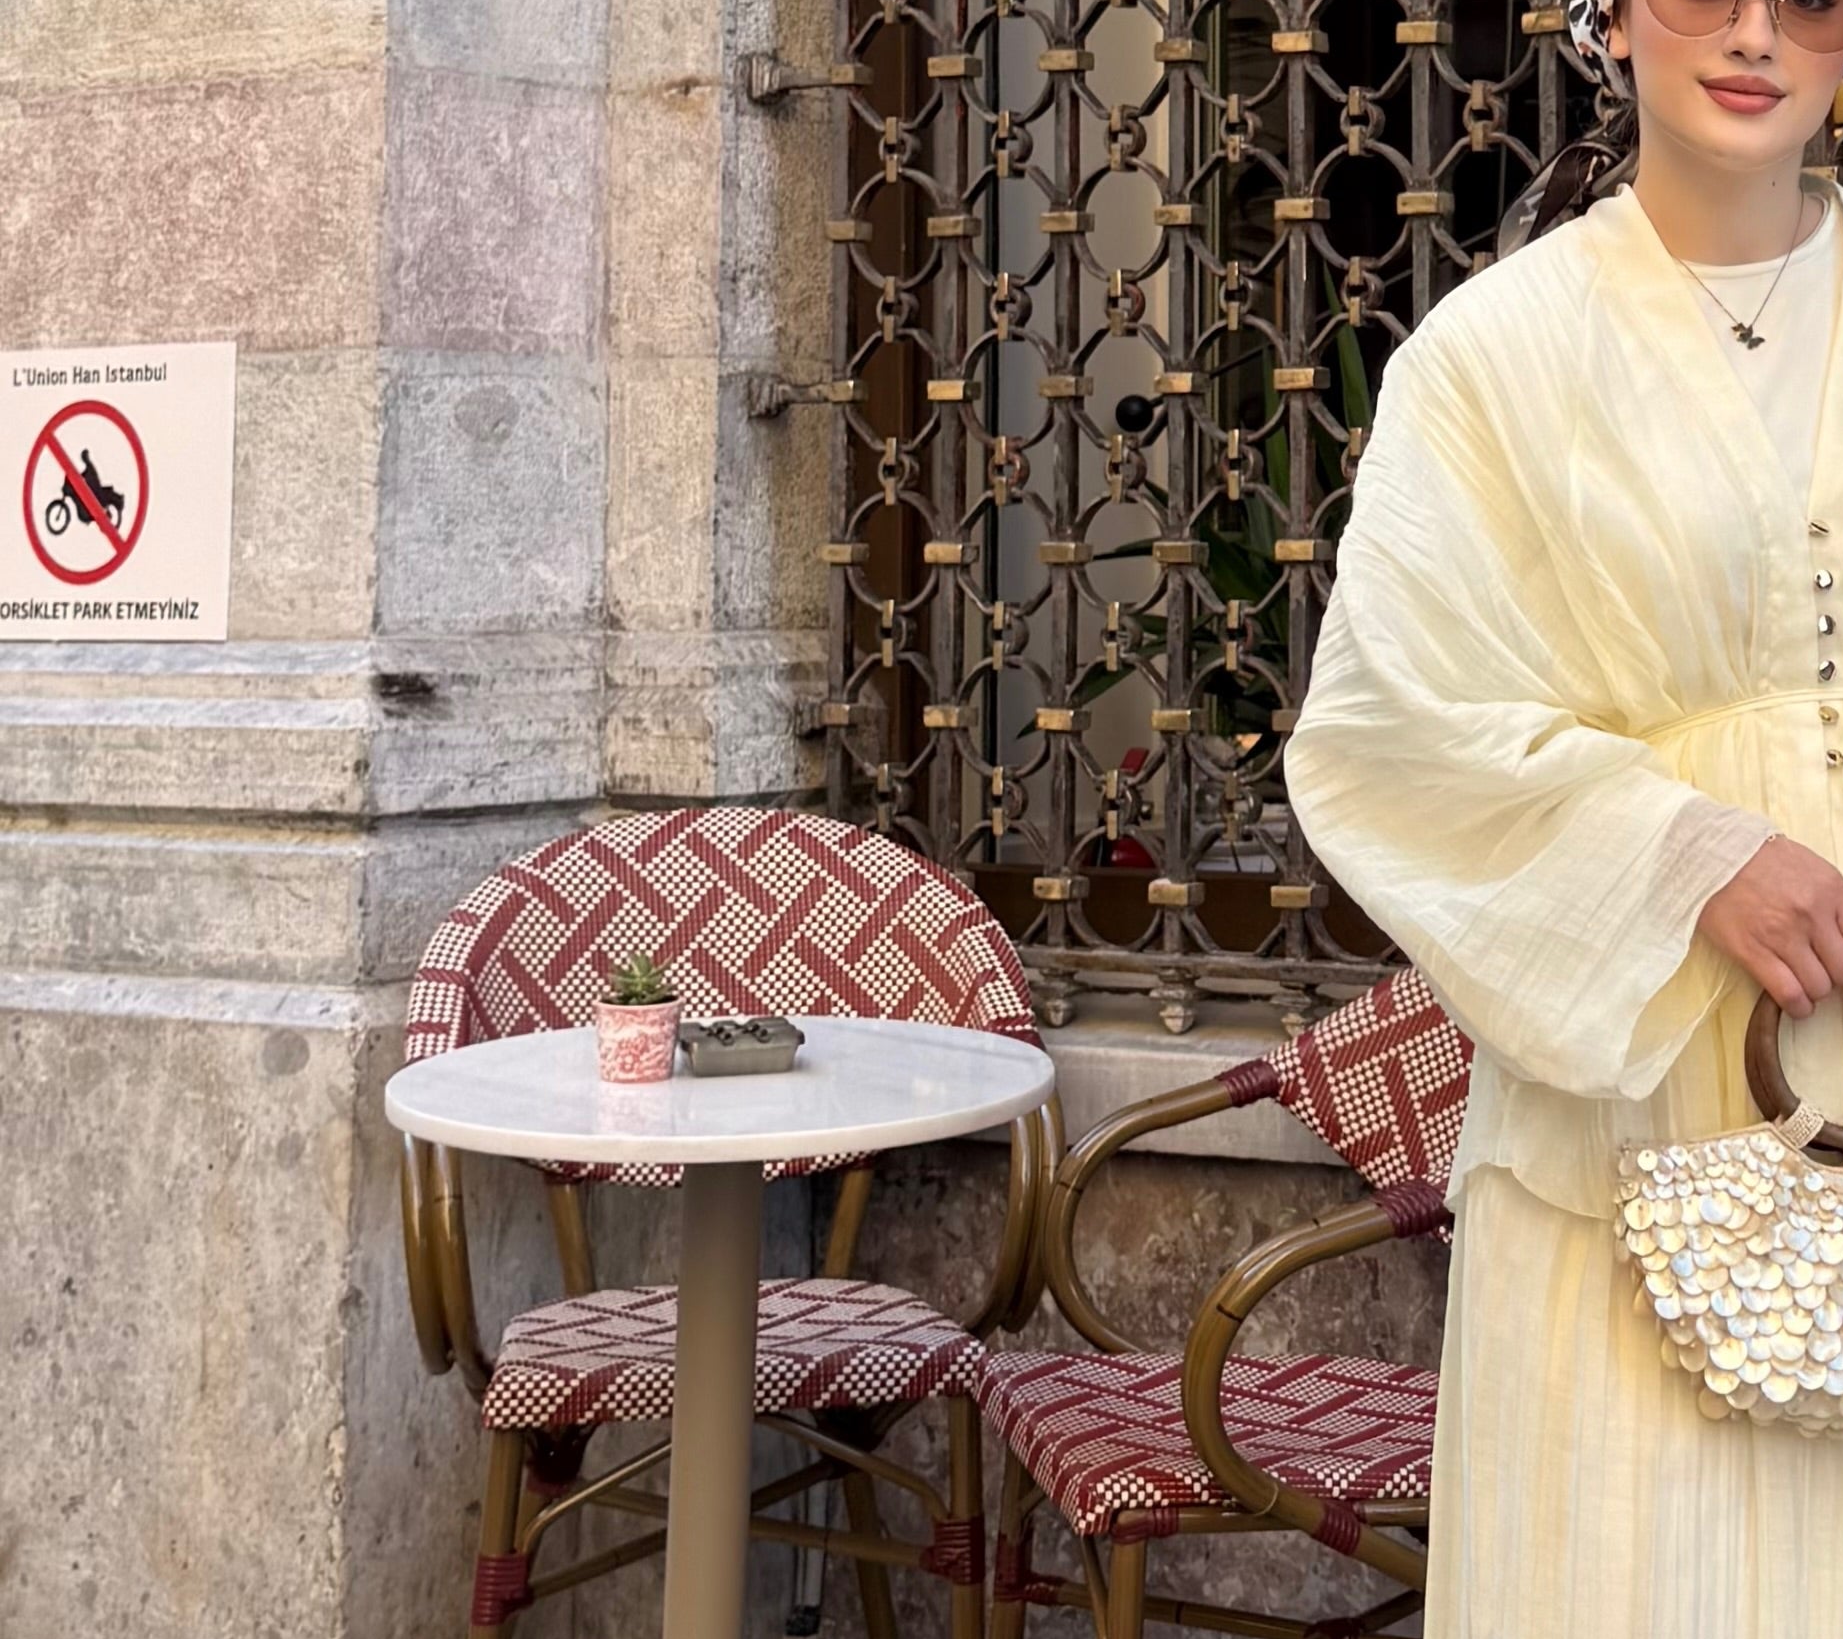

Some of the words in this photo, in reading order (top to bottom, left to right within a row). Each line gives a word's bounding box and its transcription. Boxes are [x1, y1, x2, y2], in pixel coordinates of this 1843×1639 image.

[72, 365, 100, 385] Han
[105, 361, 167, 383] Istanbul
[73, 601, 113, 620] PARK
[116, 596, 200, 620] ETMEYİNİZ
